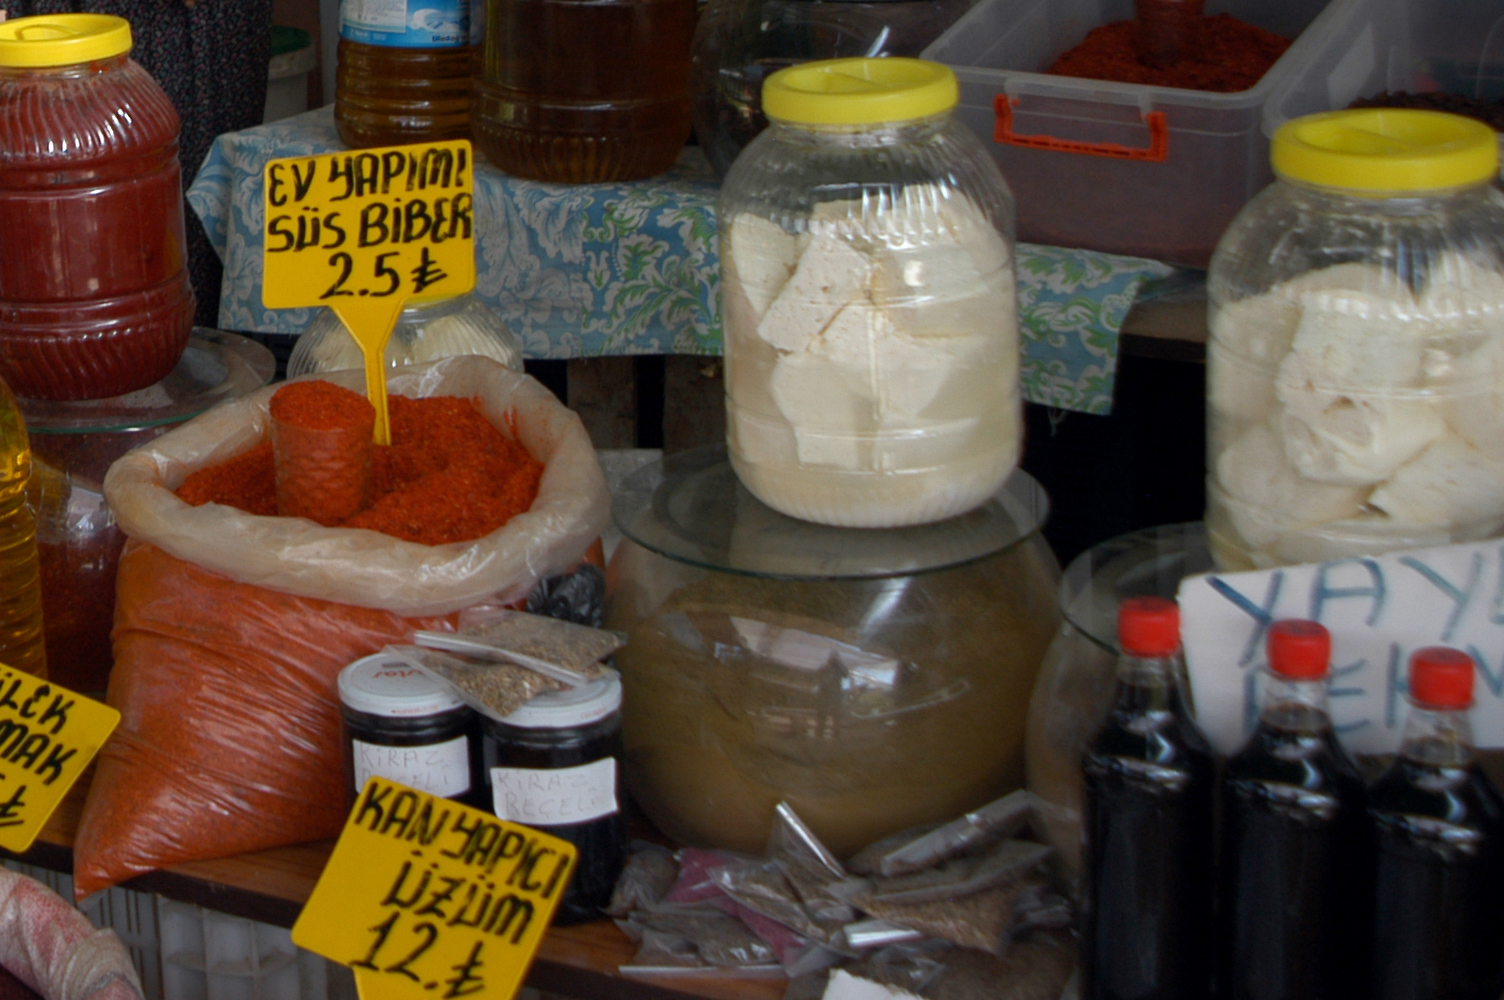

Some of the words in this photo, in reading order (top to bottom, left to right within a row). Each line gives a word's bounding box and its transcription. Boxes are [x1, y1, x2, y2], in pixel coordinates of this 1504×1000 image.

[268, 159, 317, 208] EV
[328, 147, 467, 203] YAPIMI
[267, 206, 347, 253] SÜS
[357, 191, 474, 249] BİBER
[353, 780, 451, 847] KAN
[379, 848, 536, 946] ÜZÜM
